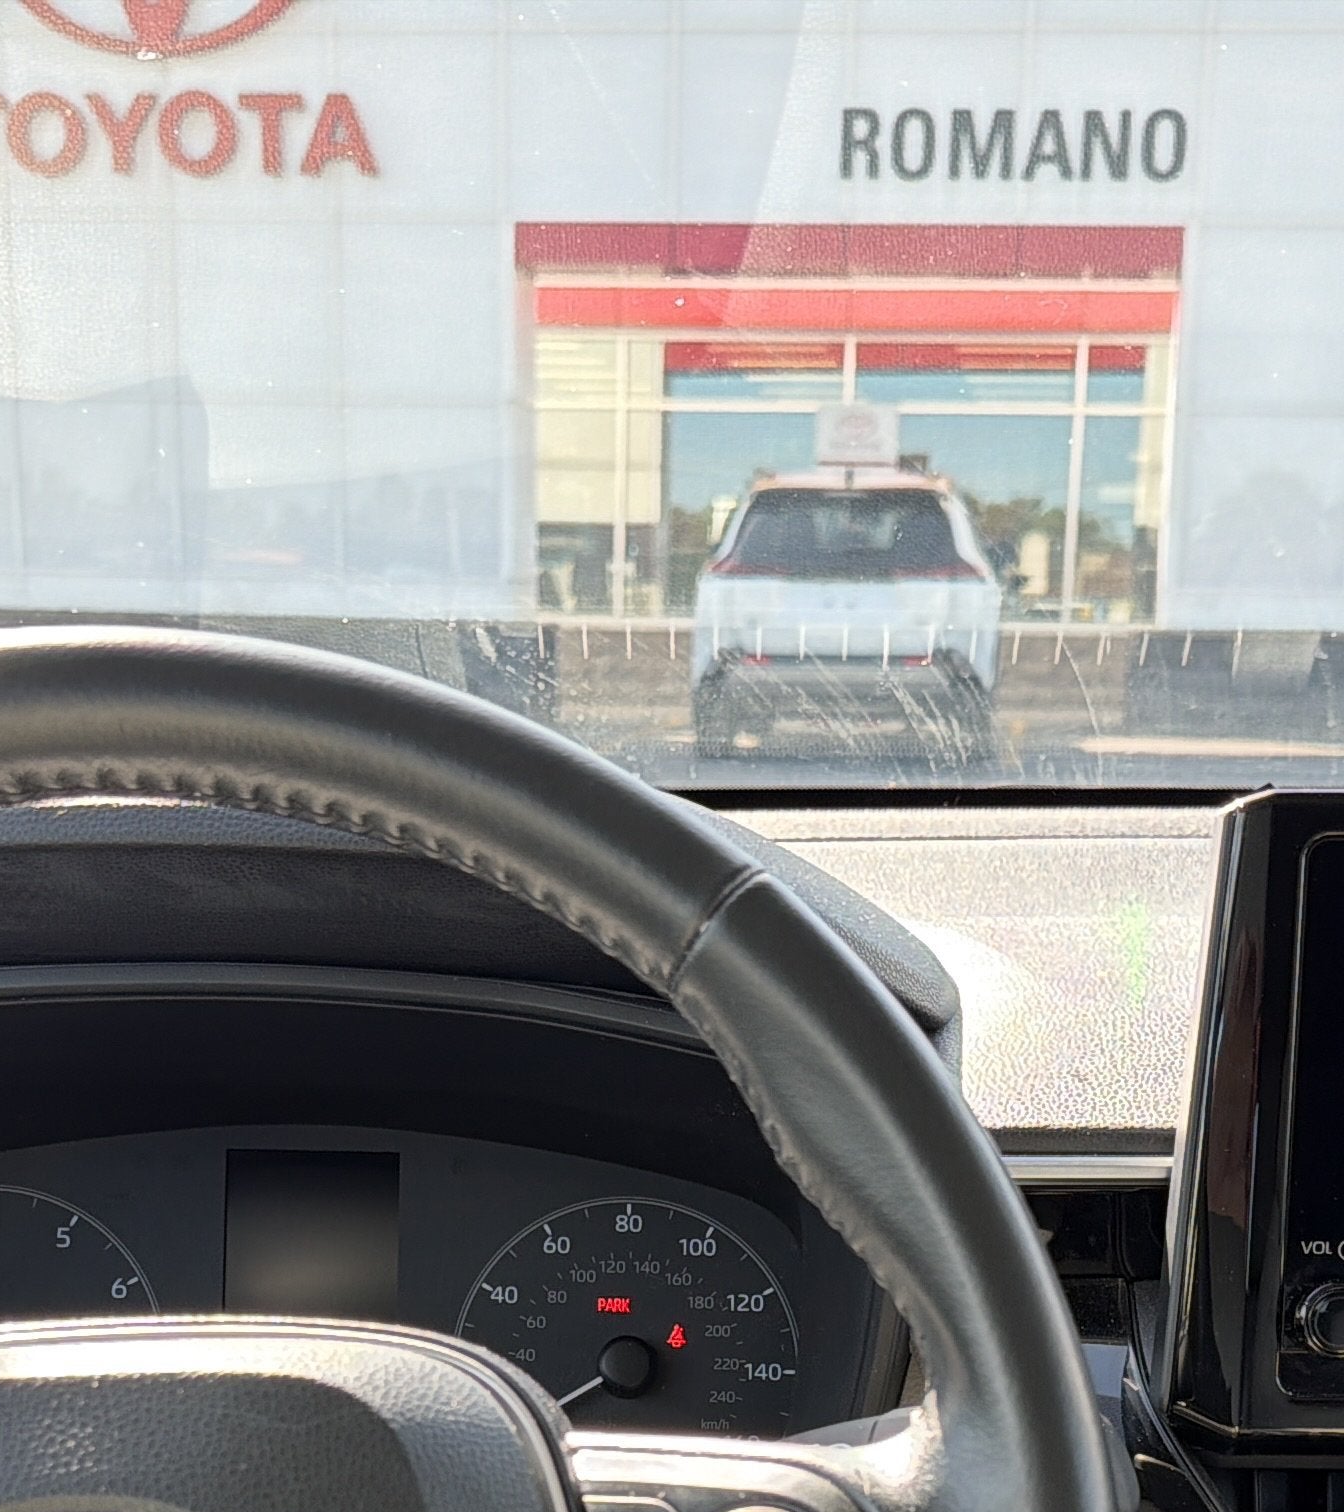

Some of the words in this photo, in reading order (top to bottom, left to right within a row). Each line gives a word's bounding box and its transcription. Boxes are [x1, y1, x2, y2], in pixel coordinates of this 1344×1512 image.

[839, 107, 1188, 184] ROMANO
[615, 1215, 643, 1233] 80
[56, 1227, 71, 1248] 5
[543, 1236, 570, 1254] 60
[679, 1238, 716, 1257] 100
[1301, 1241, 1333, 1254] VOL
[599, 1260, 626, 1274] 120
[633, 1260, 660, 1274] 140
[569, 1269, 596, 1283] 100
[665, 1272, 692, 1286] 160
[111, 1278, 127, 1299] 6
[490, 1286, 518, 1303] 40
[547, 1290, 567, 1304] 80
[688, 1296, 714, 1310] 180
[727, 1294, 764, 1312] 120
[597, 1297, 631, 1313] PARK
[526, 1315, 547, 1329] 60
[704, 1325, 731, 1338] 200
[516, 1348, 536, 1362] 40
[713, 1358, 739, 1371] 220
[744, 1363, 782, 1381] 140
[709, 1391, 736, 1403] 240
[701, 1418, 730, 1430] km/h
